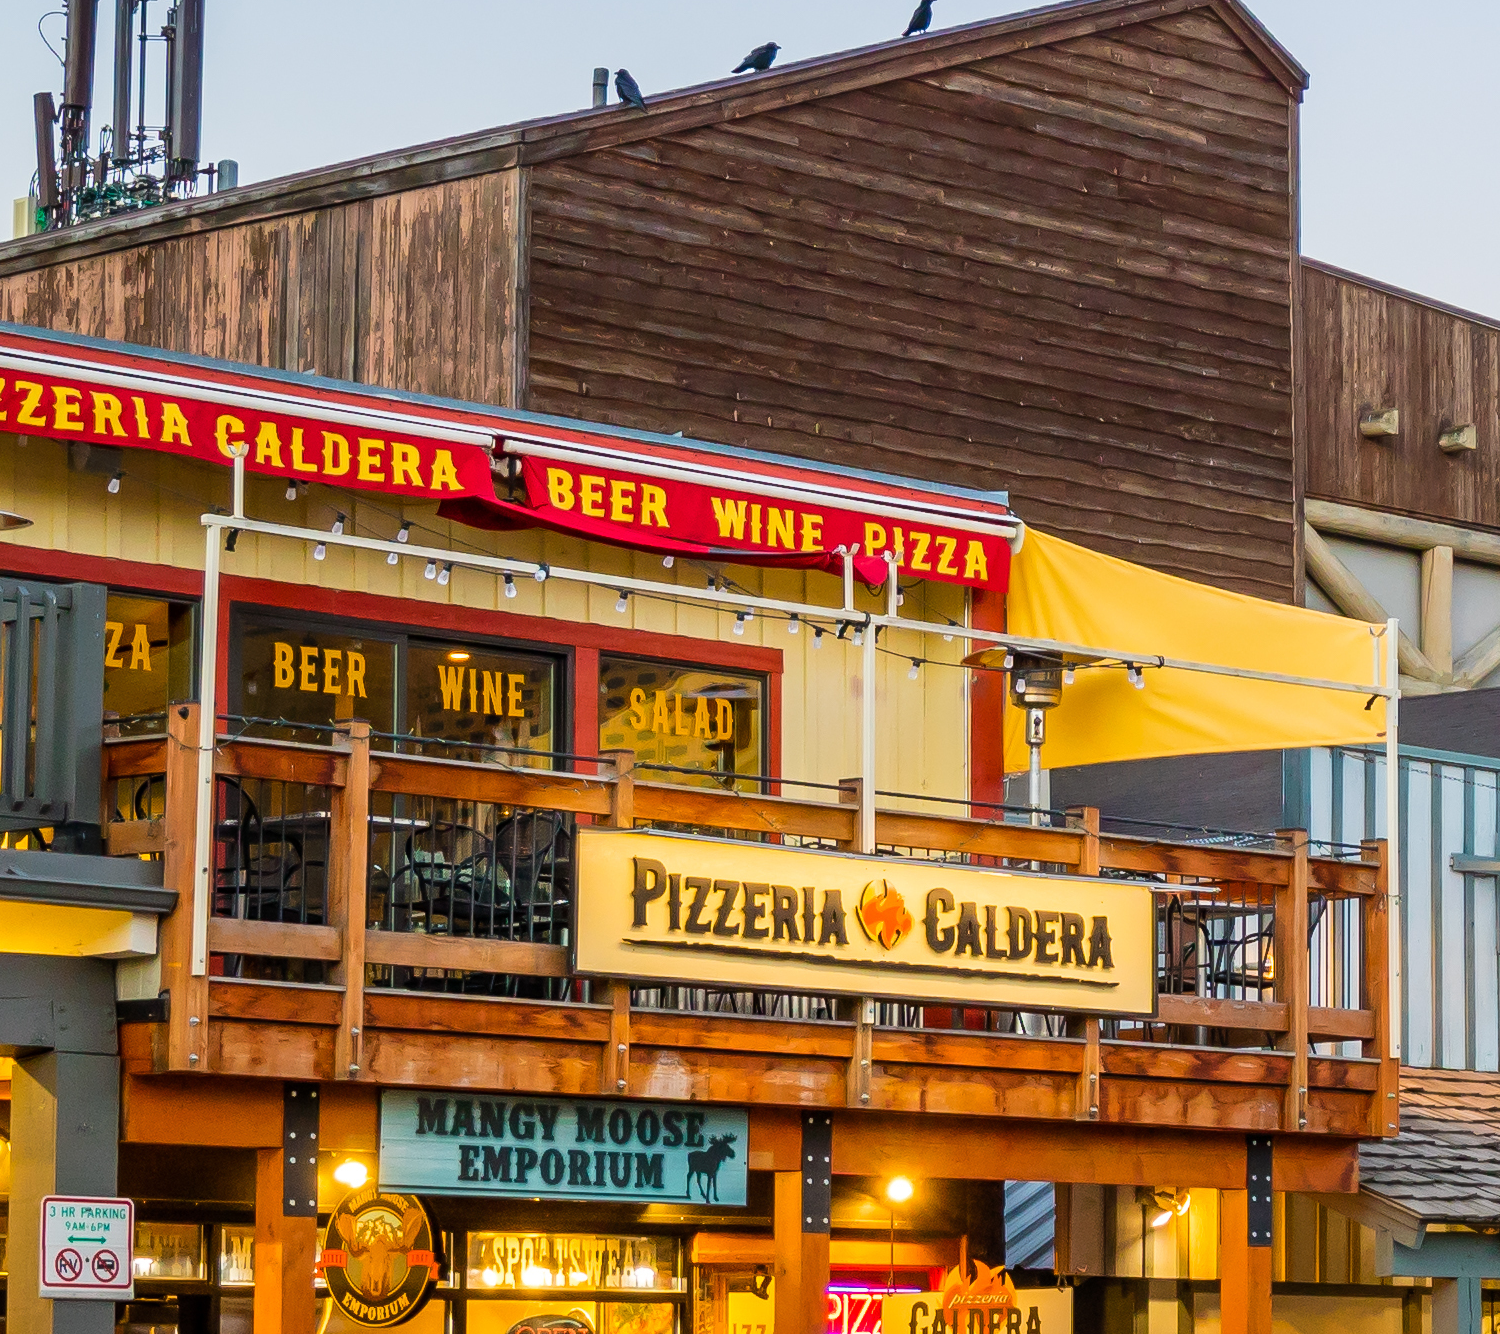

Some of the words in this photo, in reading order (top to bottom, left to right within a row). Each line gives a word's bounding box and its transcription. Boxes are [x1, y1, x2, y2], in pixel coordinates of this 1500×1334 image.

[215, 414, 465, 492] CALDERA
[547, 467, 670, 528] BEER
[710, 496, 825, 553] WINE
[864, 521, 989, 581] PIZZA
[273, 641, 367, 699] BEER
[438, 664, 525, 718] WINE
[629, 687, 734, 742] SALAD
[632, 856, 849, 946] PIZZERIA
[924, 886, 1115, 968] CALDERA
[416, 1097, 560, 1142] MANGY
[575, 1105, 706, 1148] MOOSE
[457, 1144, 665, 1189] EMPORIUM
[49, 1205, 56, 1217] 3
[61, 1207, 76, 1218] HR
[80, 1207, 127, 1220] PARKING
[341, 1292, 411, 1321] EMPORIUM
[948, 1291, 1010, 1309] pizzeria
